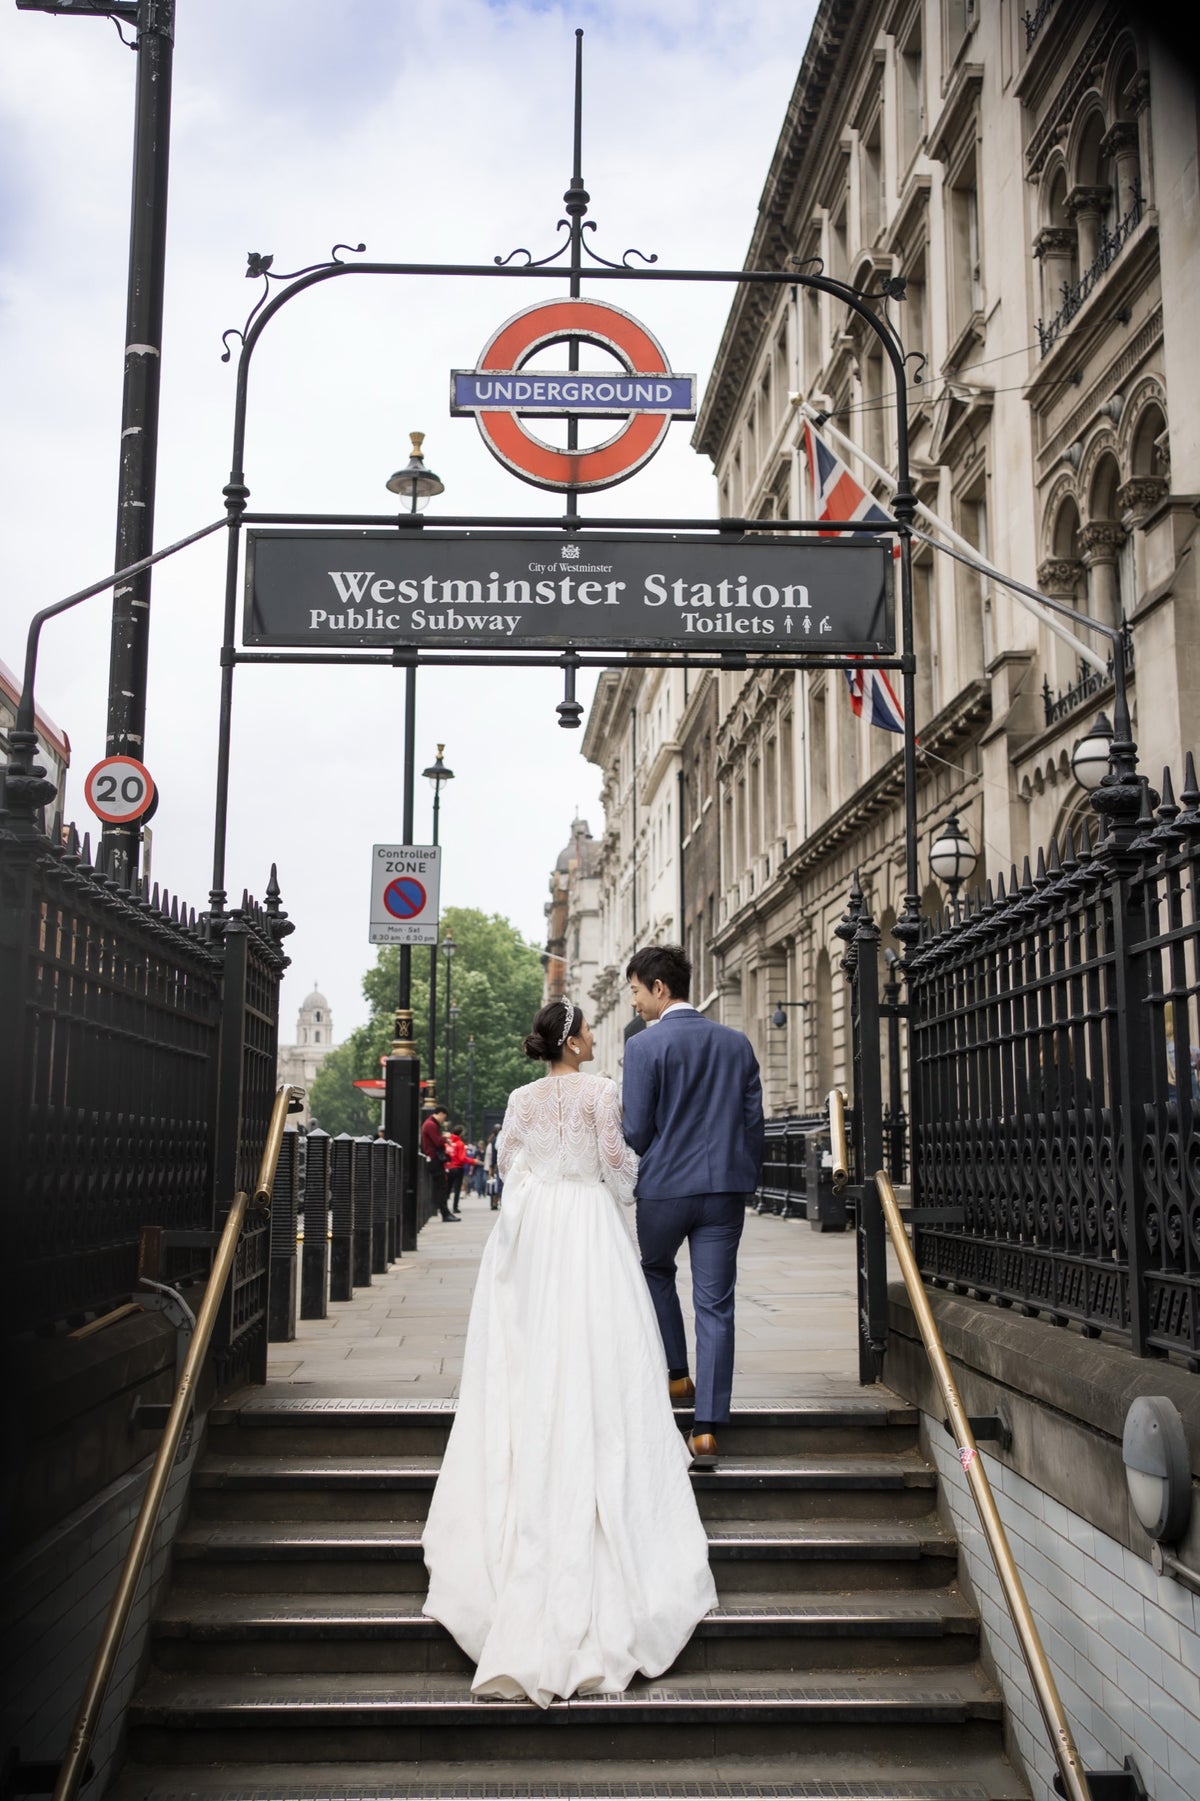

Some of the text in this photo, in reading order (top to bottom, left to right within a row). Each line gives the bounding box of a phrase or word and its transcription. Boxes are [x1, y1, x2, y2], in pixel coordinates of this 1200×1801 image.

[475, 381, 673, 402] UNDERGROUND
[528, 562, 613, 574] City of Westminster
[328, 570, 813, 609] Westminster Station
[309, 608, 522, 636] Public Subway
[681, 611, 775, 635] Toilets
[96, 775, 144, 803] 20
[377, 848, 437, 860] Controlled
[385, 861, 427, 874] ZONE
